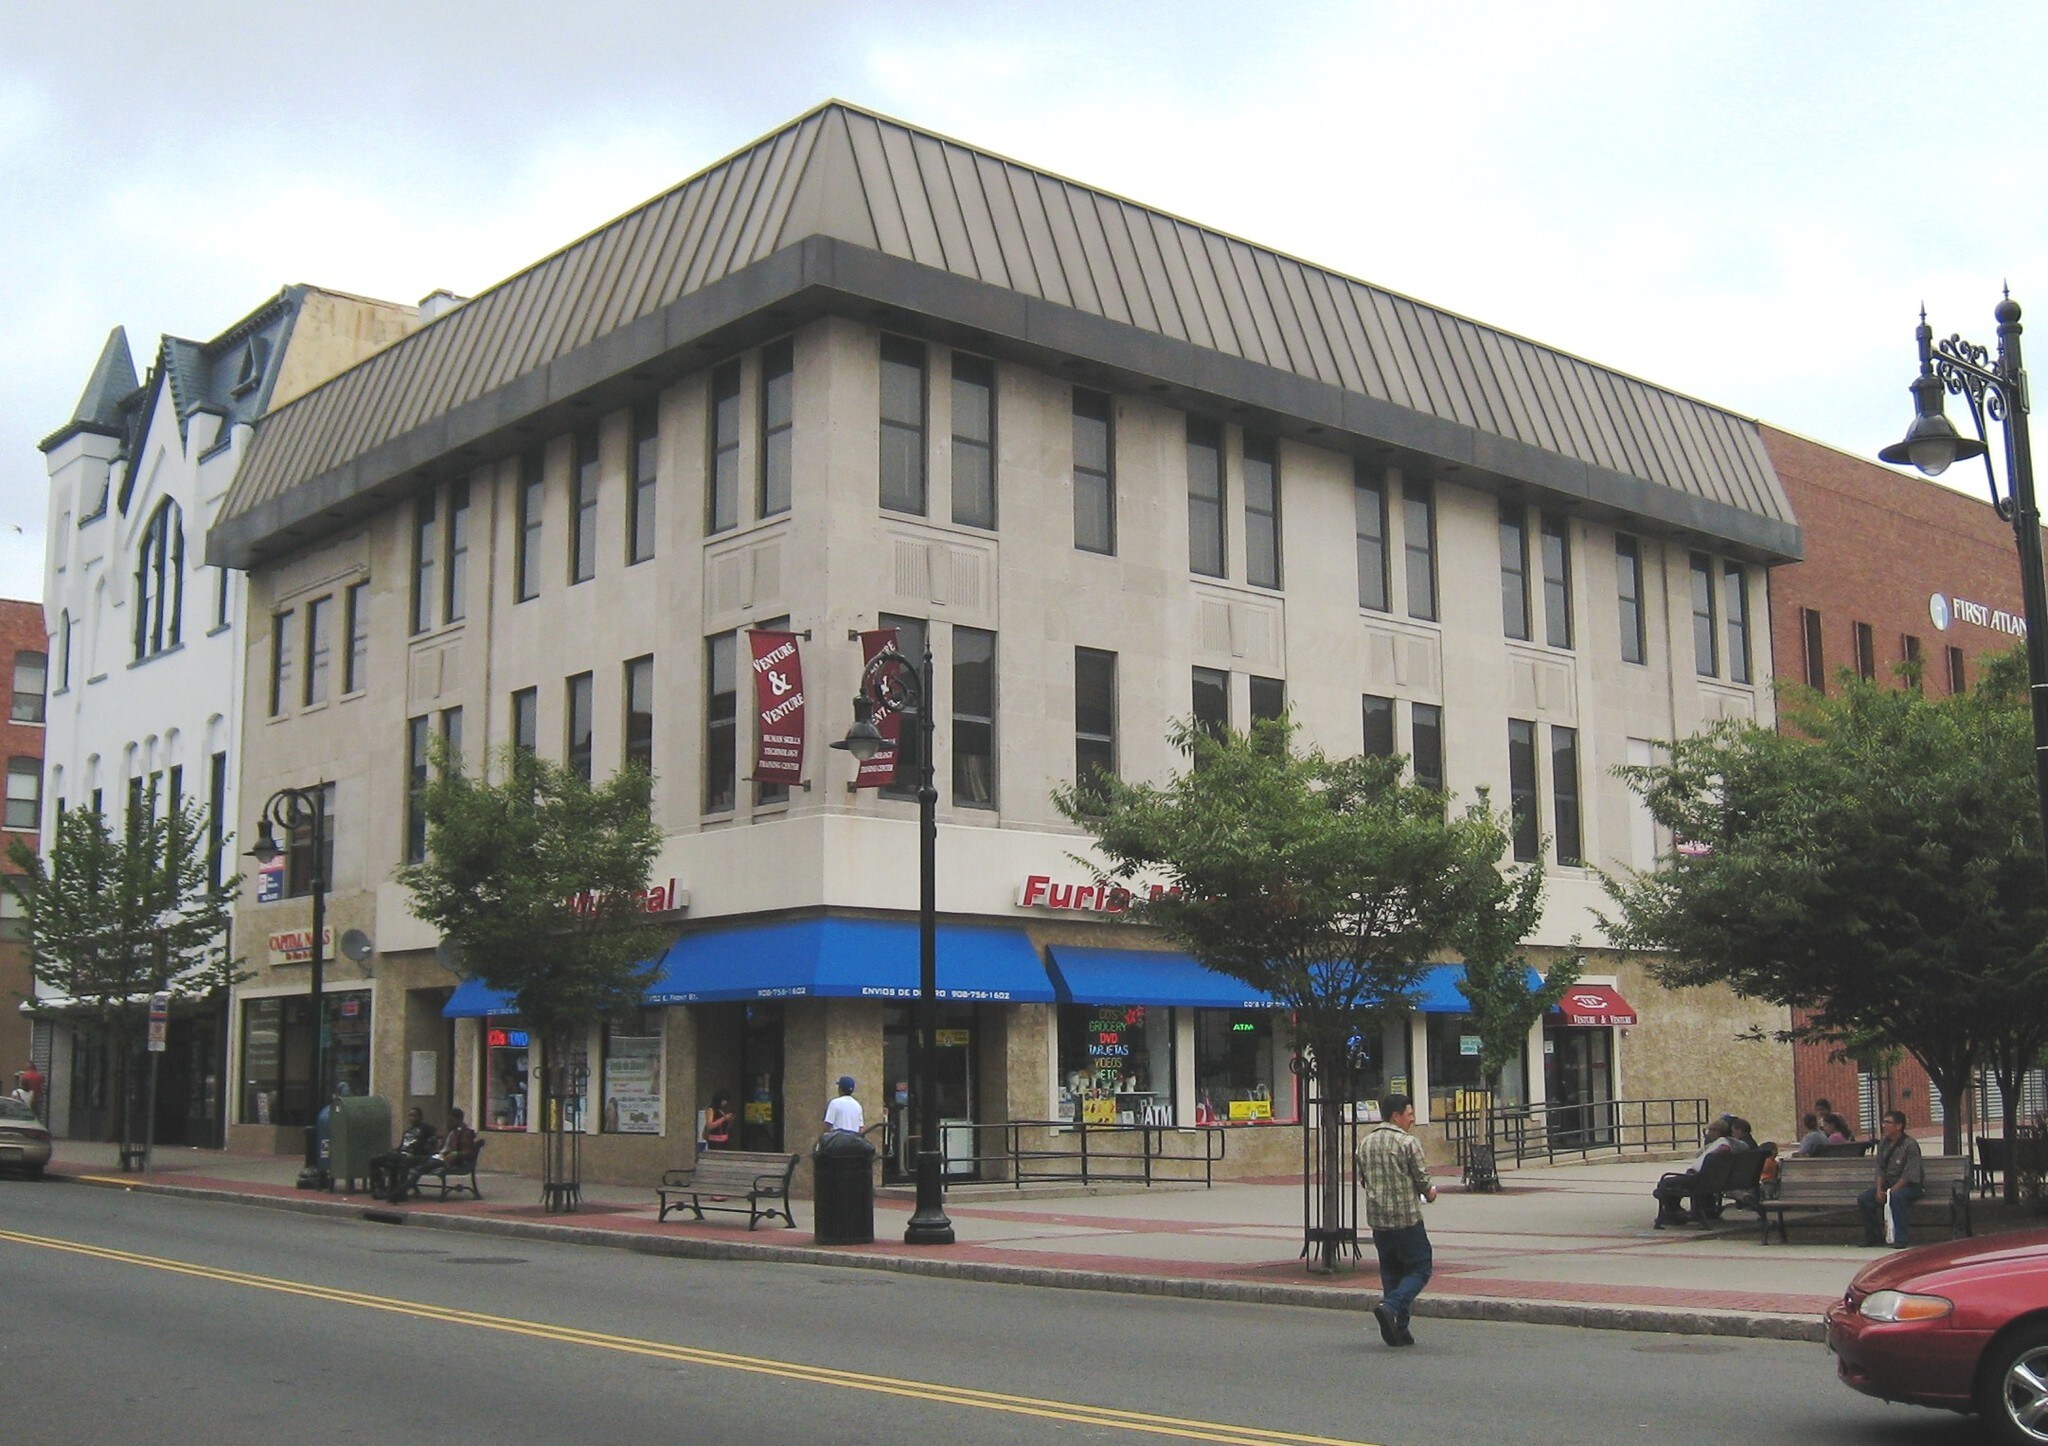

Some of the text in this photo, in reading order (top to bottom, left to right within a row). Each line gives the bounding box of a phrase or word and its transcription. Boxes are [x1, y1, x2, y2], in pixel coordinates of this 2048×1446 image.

[1952, 598, 2028, 639] FIRST ATLAN
[752, 641, 796, 674] VENTURE
[768, 670, 792, 696] &
[762, 692, 805, 726] VENTURE
[1022, 875, 1131, 913] Furia
[862, 987, 895, 996] ENVIOS
[898, 989, 910, 997] DE
[951, 991, 1010, 1000] 908-756-1602
[1089, 1020, 1127, 1032] GROCERY
[1232, 1023, 1254, 1031] ATM
[1099, 1032, 1118, 1044] DVD
[1089, 1044, 1129, 1056] TARJETAS
[1094, 1057, 1123, 1068] VIDEOS
[1100, 1069, 1118, 1080] ETC
[1144, 1105, 1172, 1127] ATM
